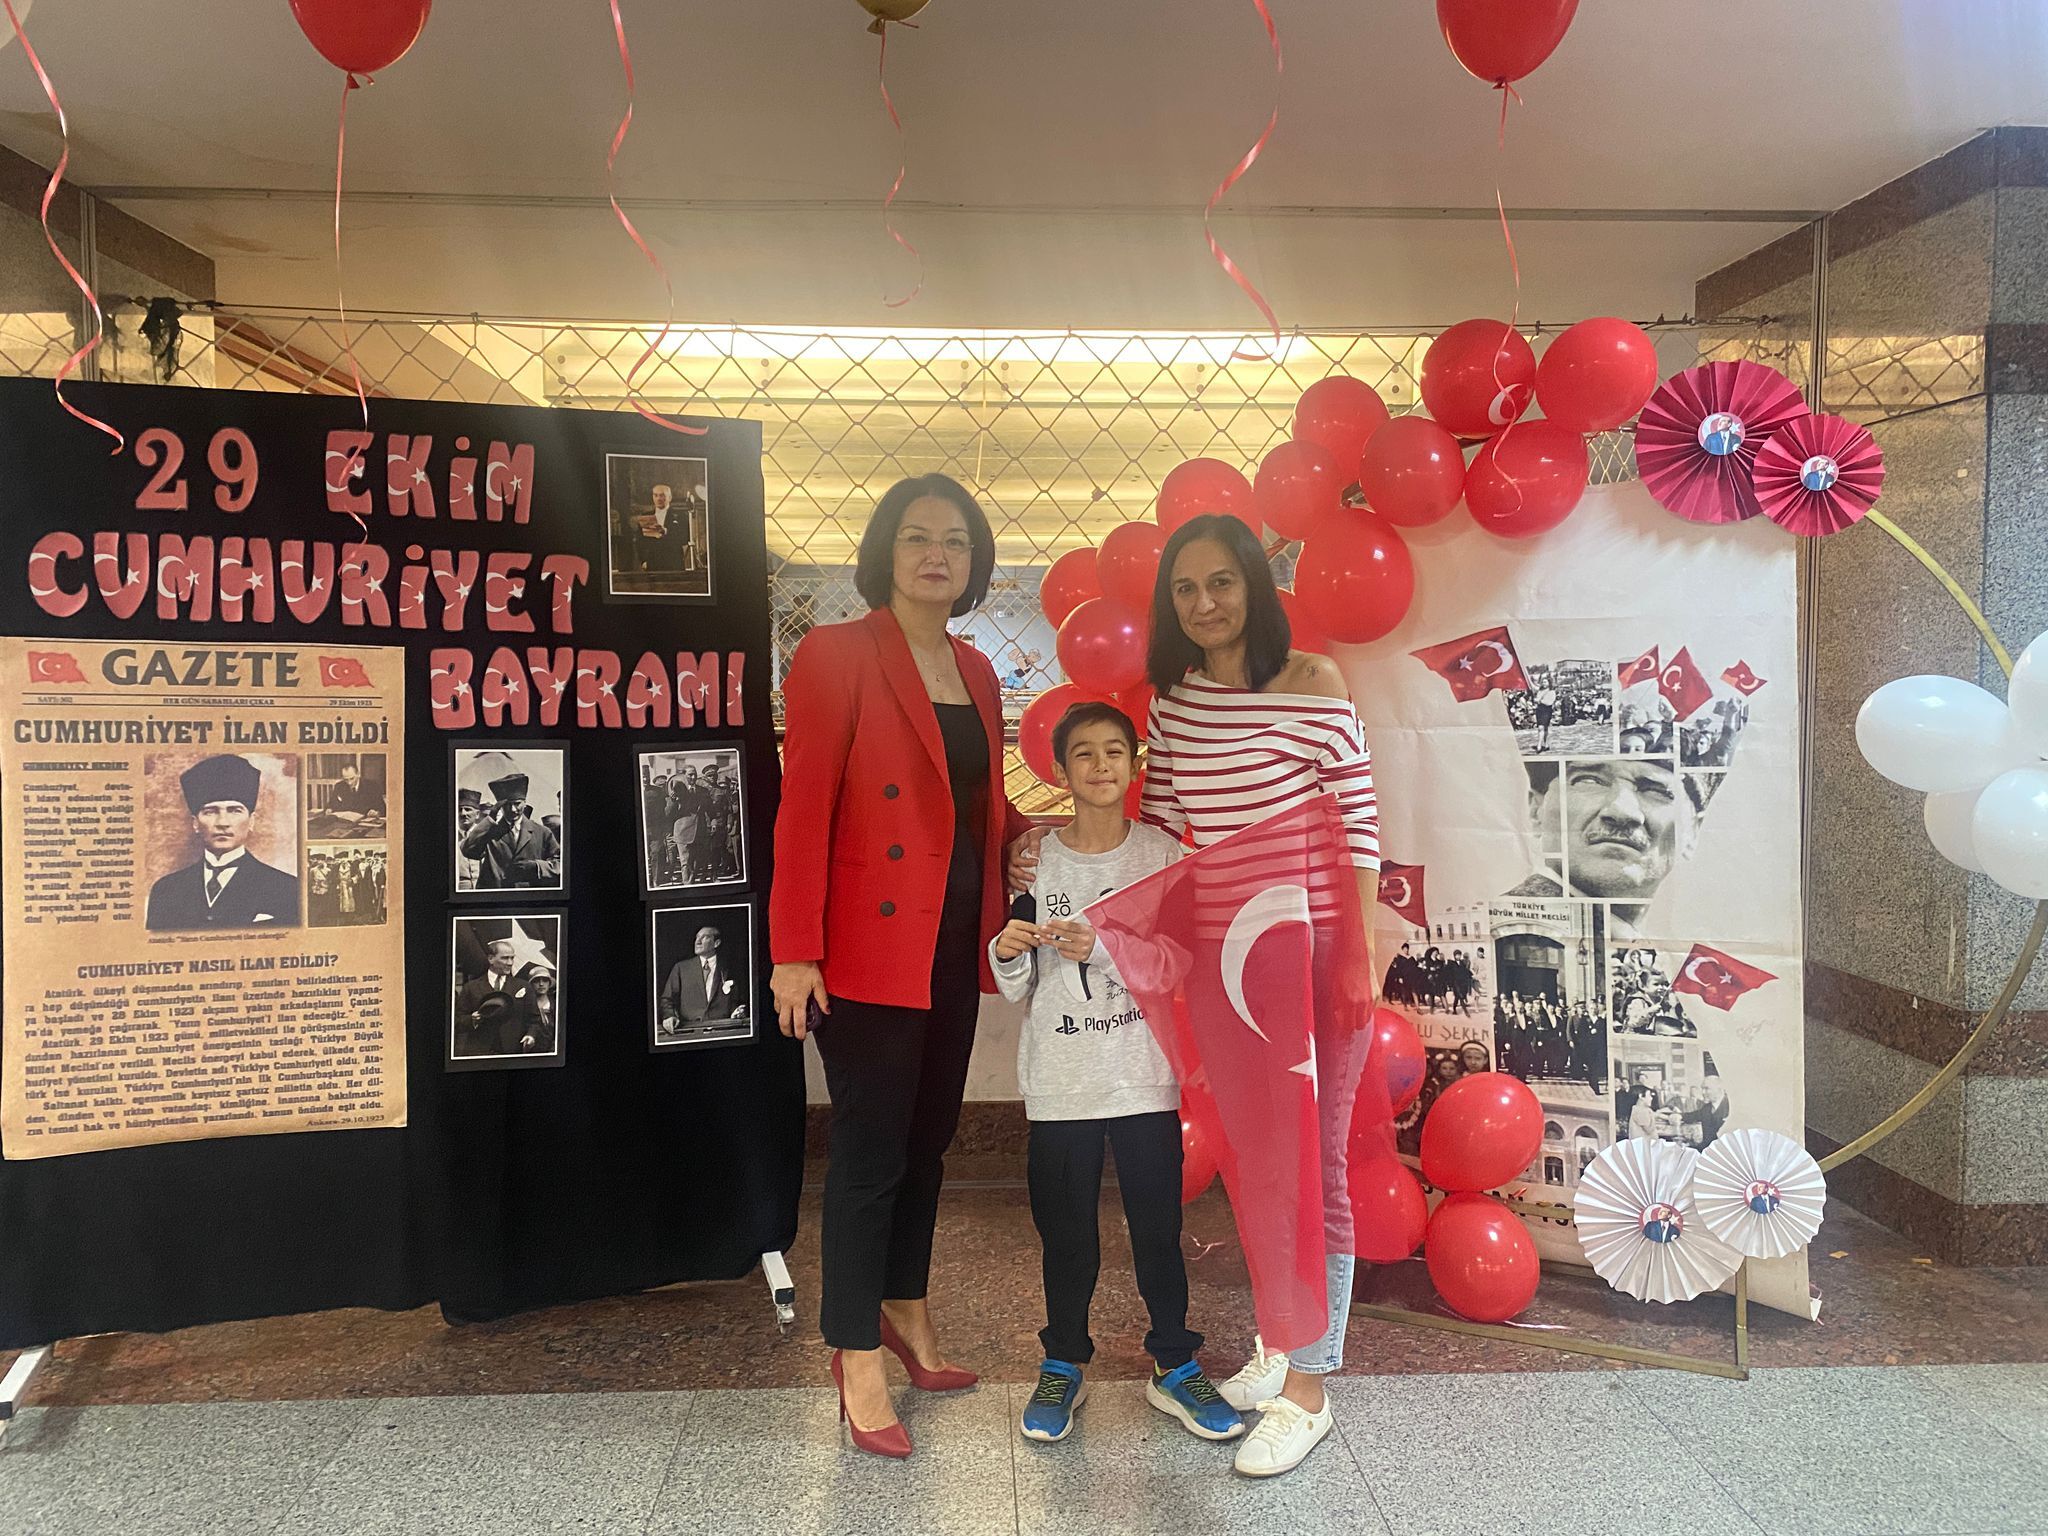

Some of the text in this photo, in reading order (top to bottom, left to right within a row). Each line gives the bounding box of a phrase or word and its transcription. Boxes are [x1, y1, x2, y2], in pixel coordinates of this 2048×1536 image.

[133, 427, 259, 513] 29
[101, 648, 300, 688] GAZETE
[429, 646, 746, 731] BAYRAMI
[14, 714, 389, 744] CUMHURİYET İLAN EDİLDİ
[1489, 909, 1513, 917] BÜYÜK
[1516, 911, 1539, 919] MİLLET
[77, 952, 339, 979] CUMHURİYET NASIL İLAN EDİLDİ?
[133, 1010, 159, 1018] Ekim
[169, 1007, 194, 1016] 1923
[1085, 1008, 1146, 1034] PlayStatio
[109, 1036, 136, 1044] Ekim
[143, 1033, 168, 1042] 1923
